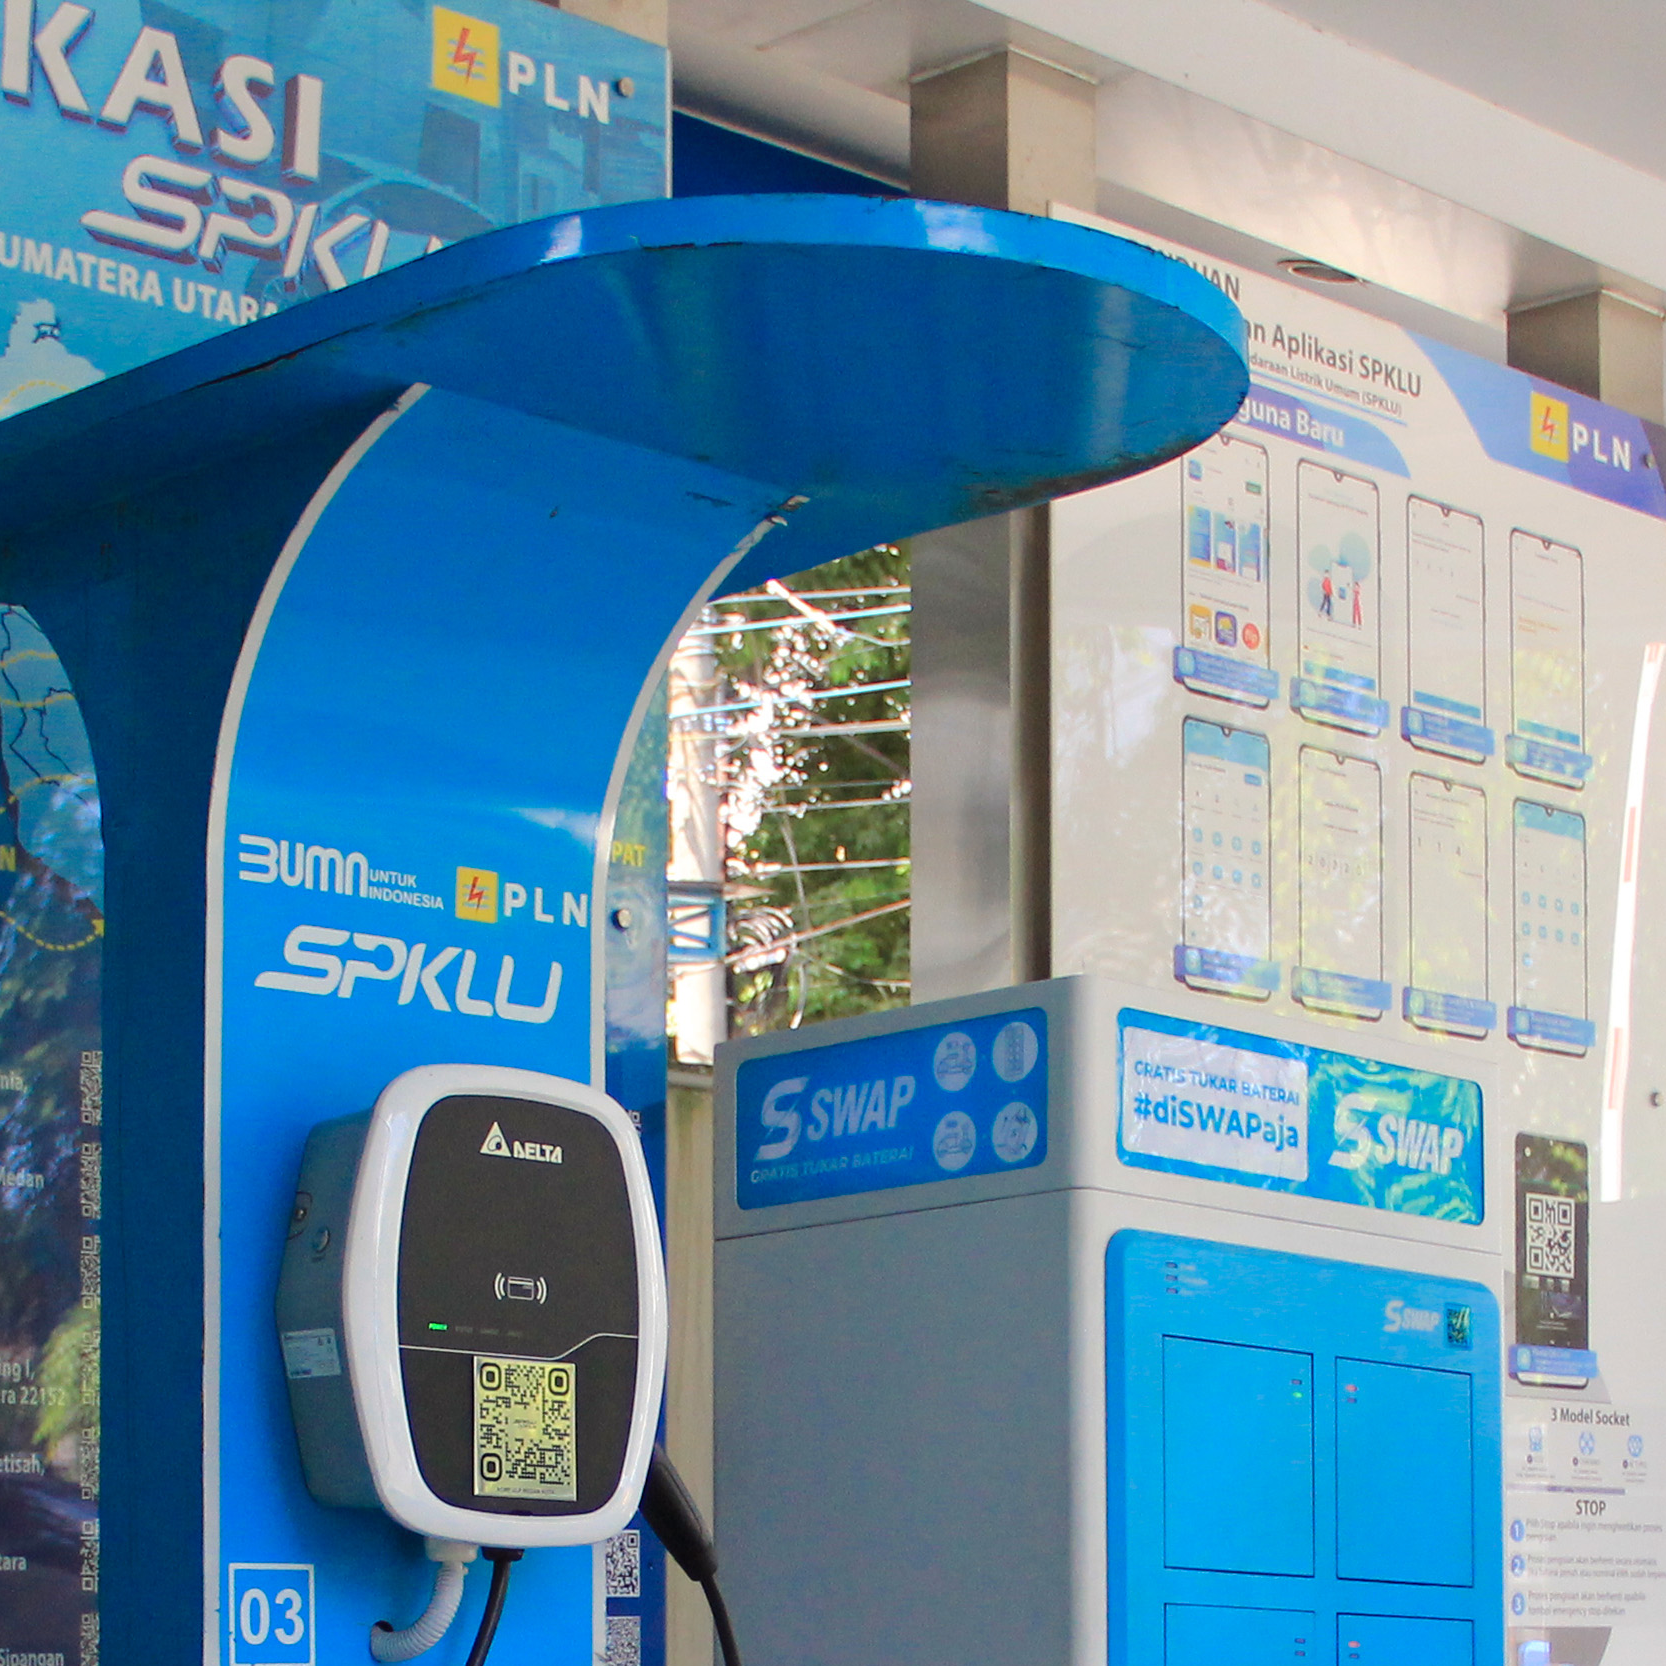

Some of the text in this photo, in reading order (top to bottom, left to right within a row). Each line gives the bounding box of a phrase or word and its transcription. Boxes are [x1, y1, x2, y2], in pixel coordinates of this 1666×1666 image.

[509, 50, 611, 125] PLN
[1272, 324, 1354, 374] Aplikasi
[1359, 355, 1422, 399] SPKLU
[1290, 366, 1323, 387] Listrik
[1325, 378, 1359, 400] Umum
[1361, 389, 1403, 418] (SPKLU)
[1296, 411, 1345, 448] Baru
[1572, 420, 1632, 473] PLN
[238, 833, 369, 898] BUMN
[368, 867, 417, 888] UNTUK
[368, 885, 445, 911] INDONESIA
[503, 881, 589, 929] PLN
[254, 924, 564, 1025] SPKLU
[806, 1075, 916, 1141] SWAP
[1134, 1058, 1301, 1108] GRATIS TUKAR BATERAI
[1133, 1092, 1299, 1151] #diSWAPaja
[1375, 1112, 1465, 1177] SWAP
[513, 1140, 564, 1165] DELTA
[1551, 1408, 1630, 1427] 3 Model Socket
[1576, 1499, 1606, 1516] STOP
[239, 1587, 305, 1646] 03
